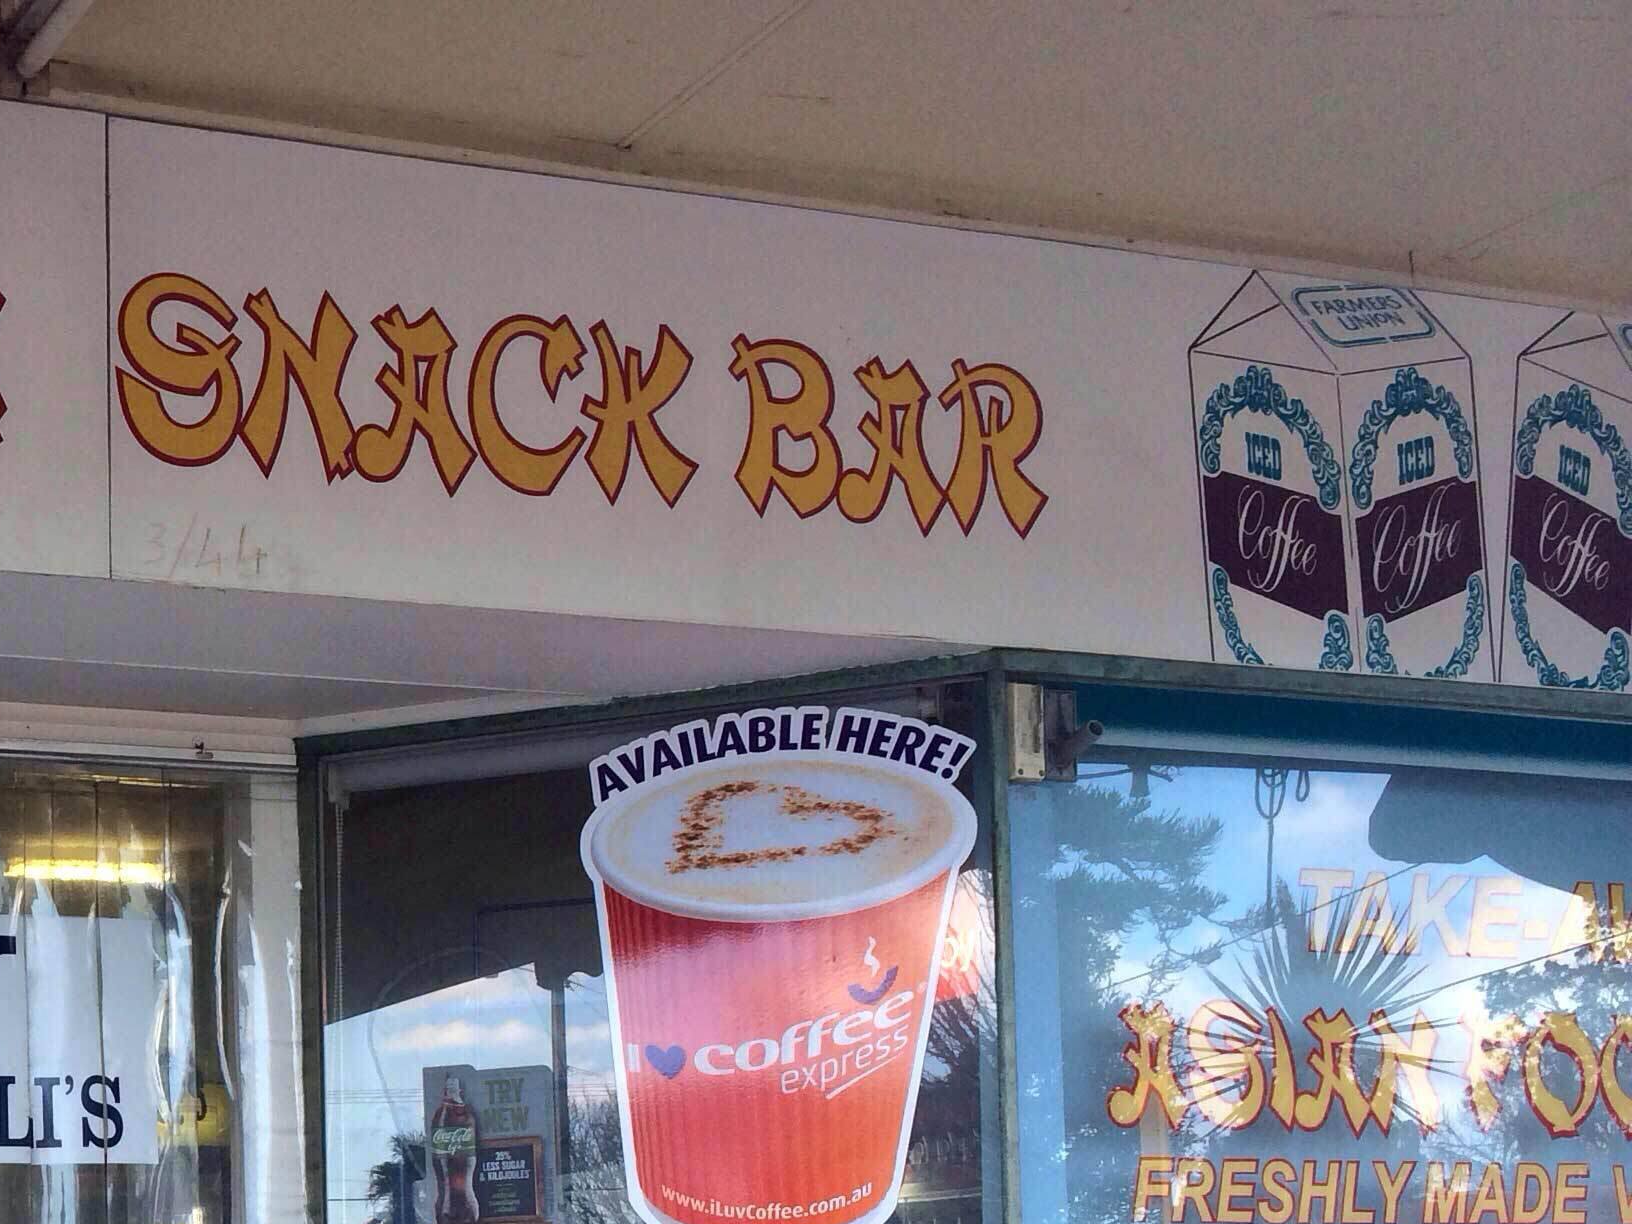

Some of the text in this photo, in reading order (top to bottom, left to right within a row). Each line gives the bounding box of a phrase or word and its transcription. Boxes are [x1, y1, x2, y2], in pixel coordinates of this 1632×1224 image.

[1310, 294, 1399, 317] FARMERS
[1337, 313, 1405, 331] UNION
[115, 272, 699, 508] SNACK
[731, 332, 1048, 539] BAR
[1245, 432, 1282, 481] ICED
[1397, 435, 1435, 485] ICED
[1559, 444, 1591, 496] ICED
[145, 520, 270, 578] 3/44
[1238, 485, 1317, 593] Coffee
[1372, 482, 1461, 613] Coffee
[1539, 492, 1610, 598] Coffee
[595, 711, 972, 801] AVAILABLE HERE!
[694, 991, 914, 1075] coffee
[781, 1025, 909, 1094] express
[483, 1078, 526, 1105] TRY
[1107, 1000, 1439, 1139] ASIAN
[481, 1104, 529, 1132] NEW
[482, 1159, 526, 1171] LESS SUGAR
[1133, 1156, 1416, 1224] FRESHLY
[661, 1182, 872, 1221] www.iLuvCoffee.com.au
